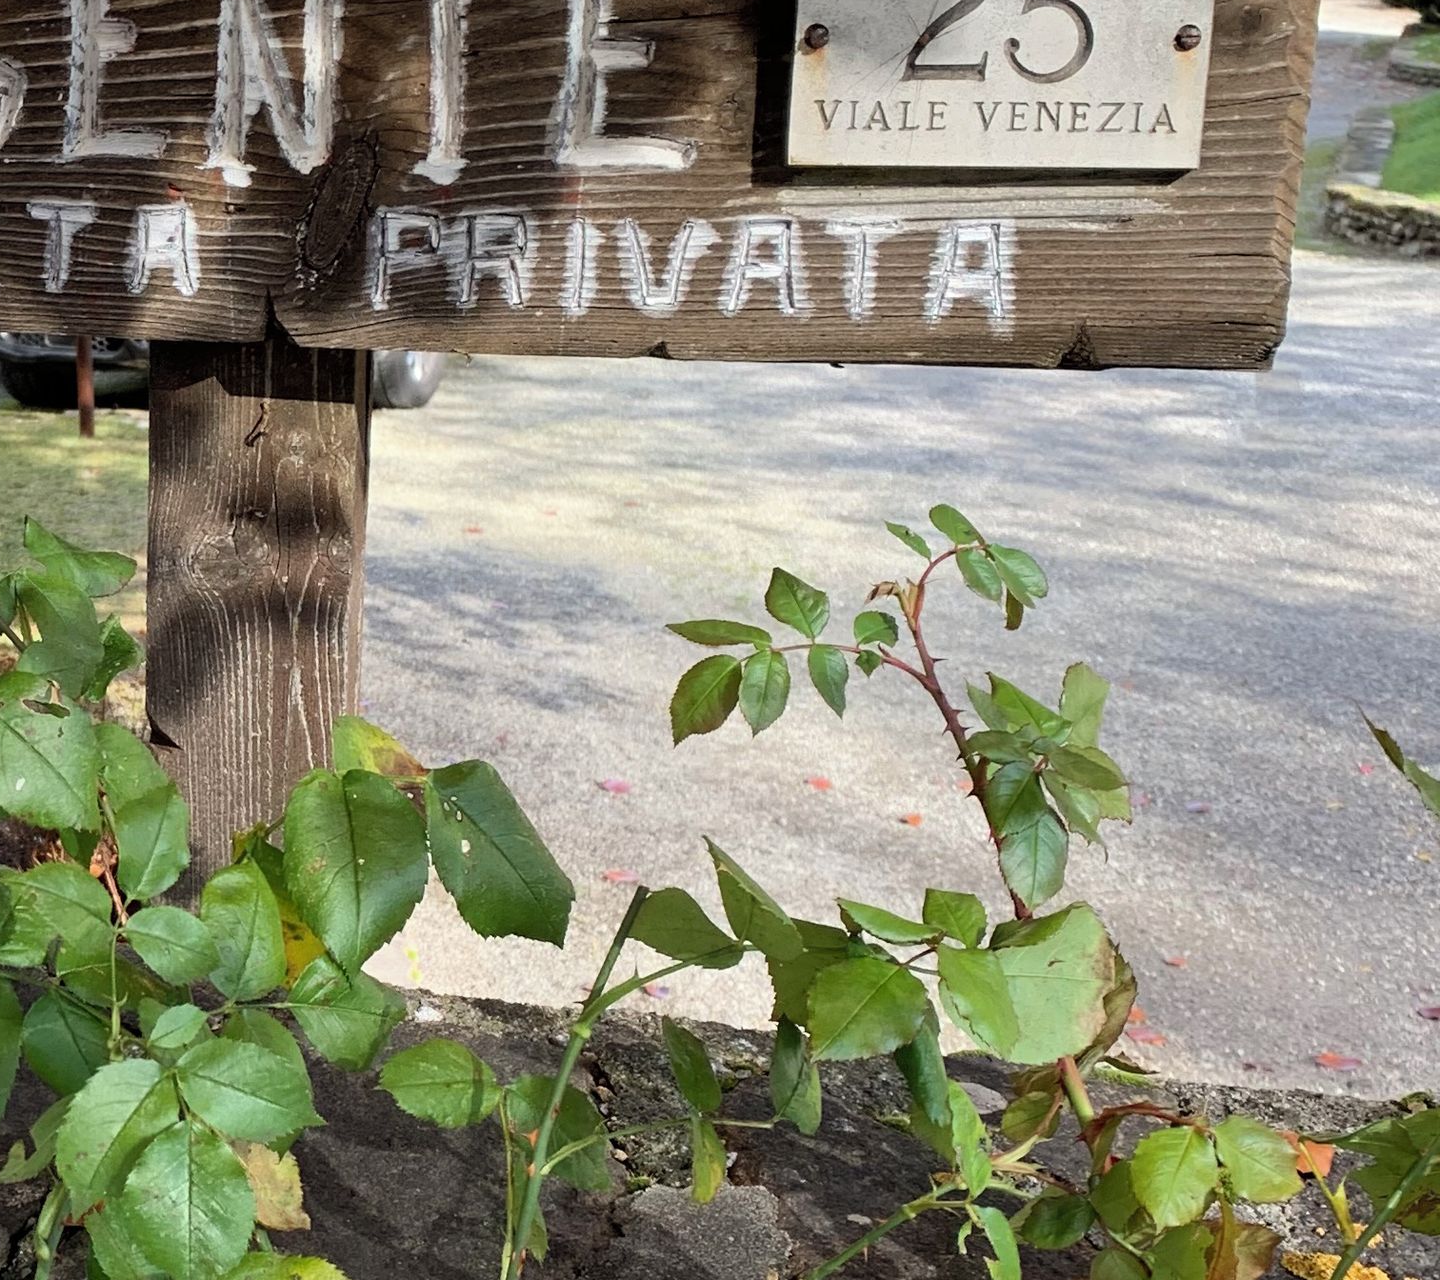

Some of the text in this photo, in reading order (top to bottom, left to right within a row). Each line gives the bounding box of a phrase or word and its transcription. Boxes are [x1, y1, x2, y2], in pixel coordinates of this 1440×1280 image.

[813, 98, 1178, 135] VIALE VENEZIA
[368, 206, 1019, 336] PRIVATA
